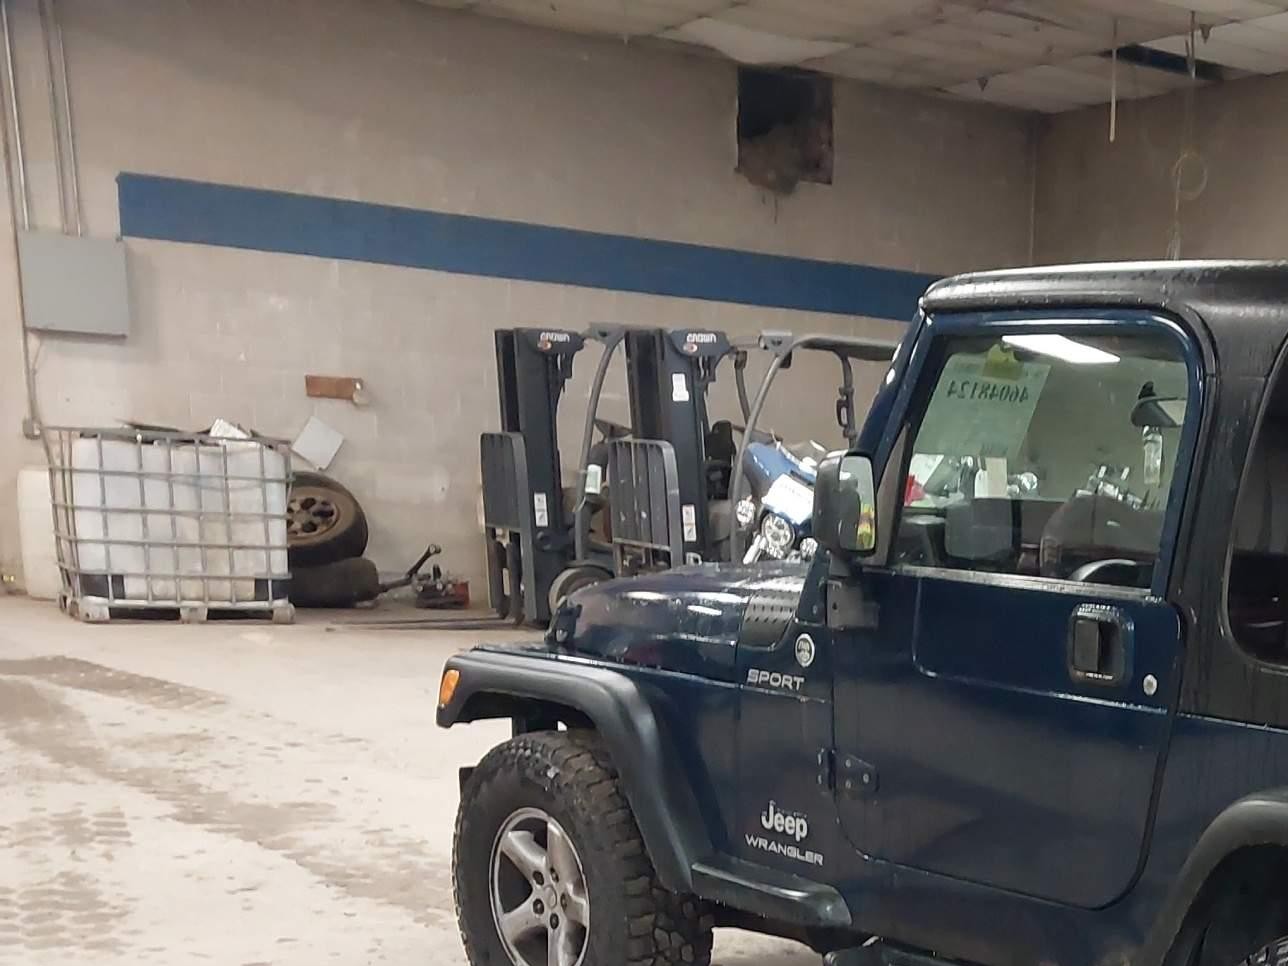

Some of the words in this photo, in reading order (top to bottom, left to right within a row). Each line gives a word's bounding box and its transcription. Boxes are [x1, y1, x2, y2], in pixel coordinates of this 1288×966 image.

[686, 332, 717, 343] CROWN
[747, 668, 805, 691] SPORT
[761, 799, 808, 842] Jeep
[745, 833, 824, 867] WRANGLER
